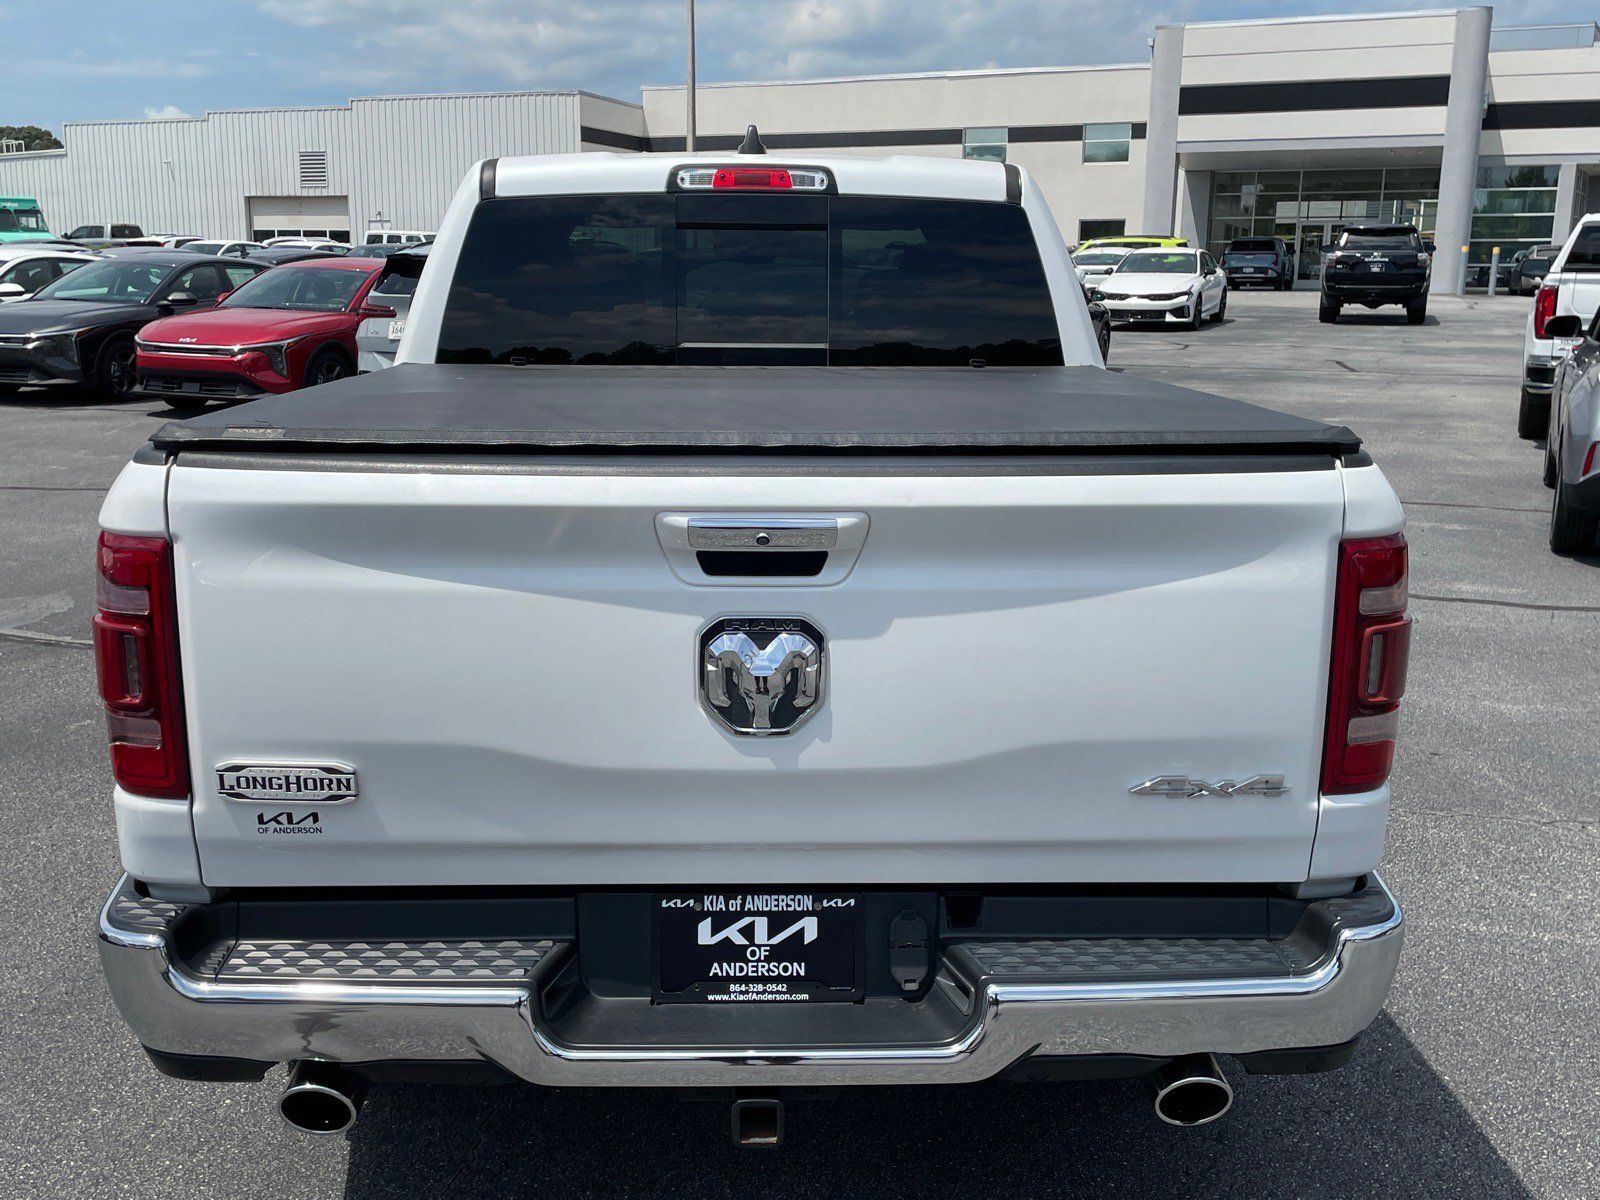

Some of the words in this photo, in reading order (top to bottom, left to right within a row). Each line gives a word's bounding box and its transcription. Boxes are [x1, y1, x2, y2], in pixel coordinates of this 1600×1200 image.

[724, 620, 800, 630] RAM
[257, 812, 320, 825] KIA
[272, 826, 322, 834] ANDERSON
[661, 899, 694, 907] KIA
[704, 895, 726, 911] KIA
[728, 895, 742, 911] of
[745, 895, 813, 911] ANDERSON
[822, 898, 855, 907] KIA
[697, 916, 818, 945] KIA
[746, 946, 770, 961] OF
[709, 962, 805, 976] ANDERSON
[729, 983, 787, 992] 864-328-0542
[707, 992, 809, 1001] www.KiaofAnderson.com
